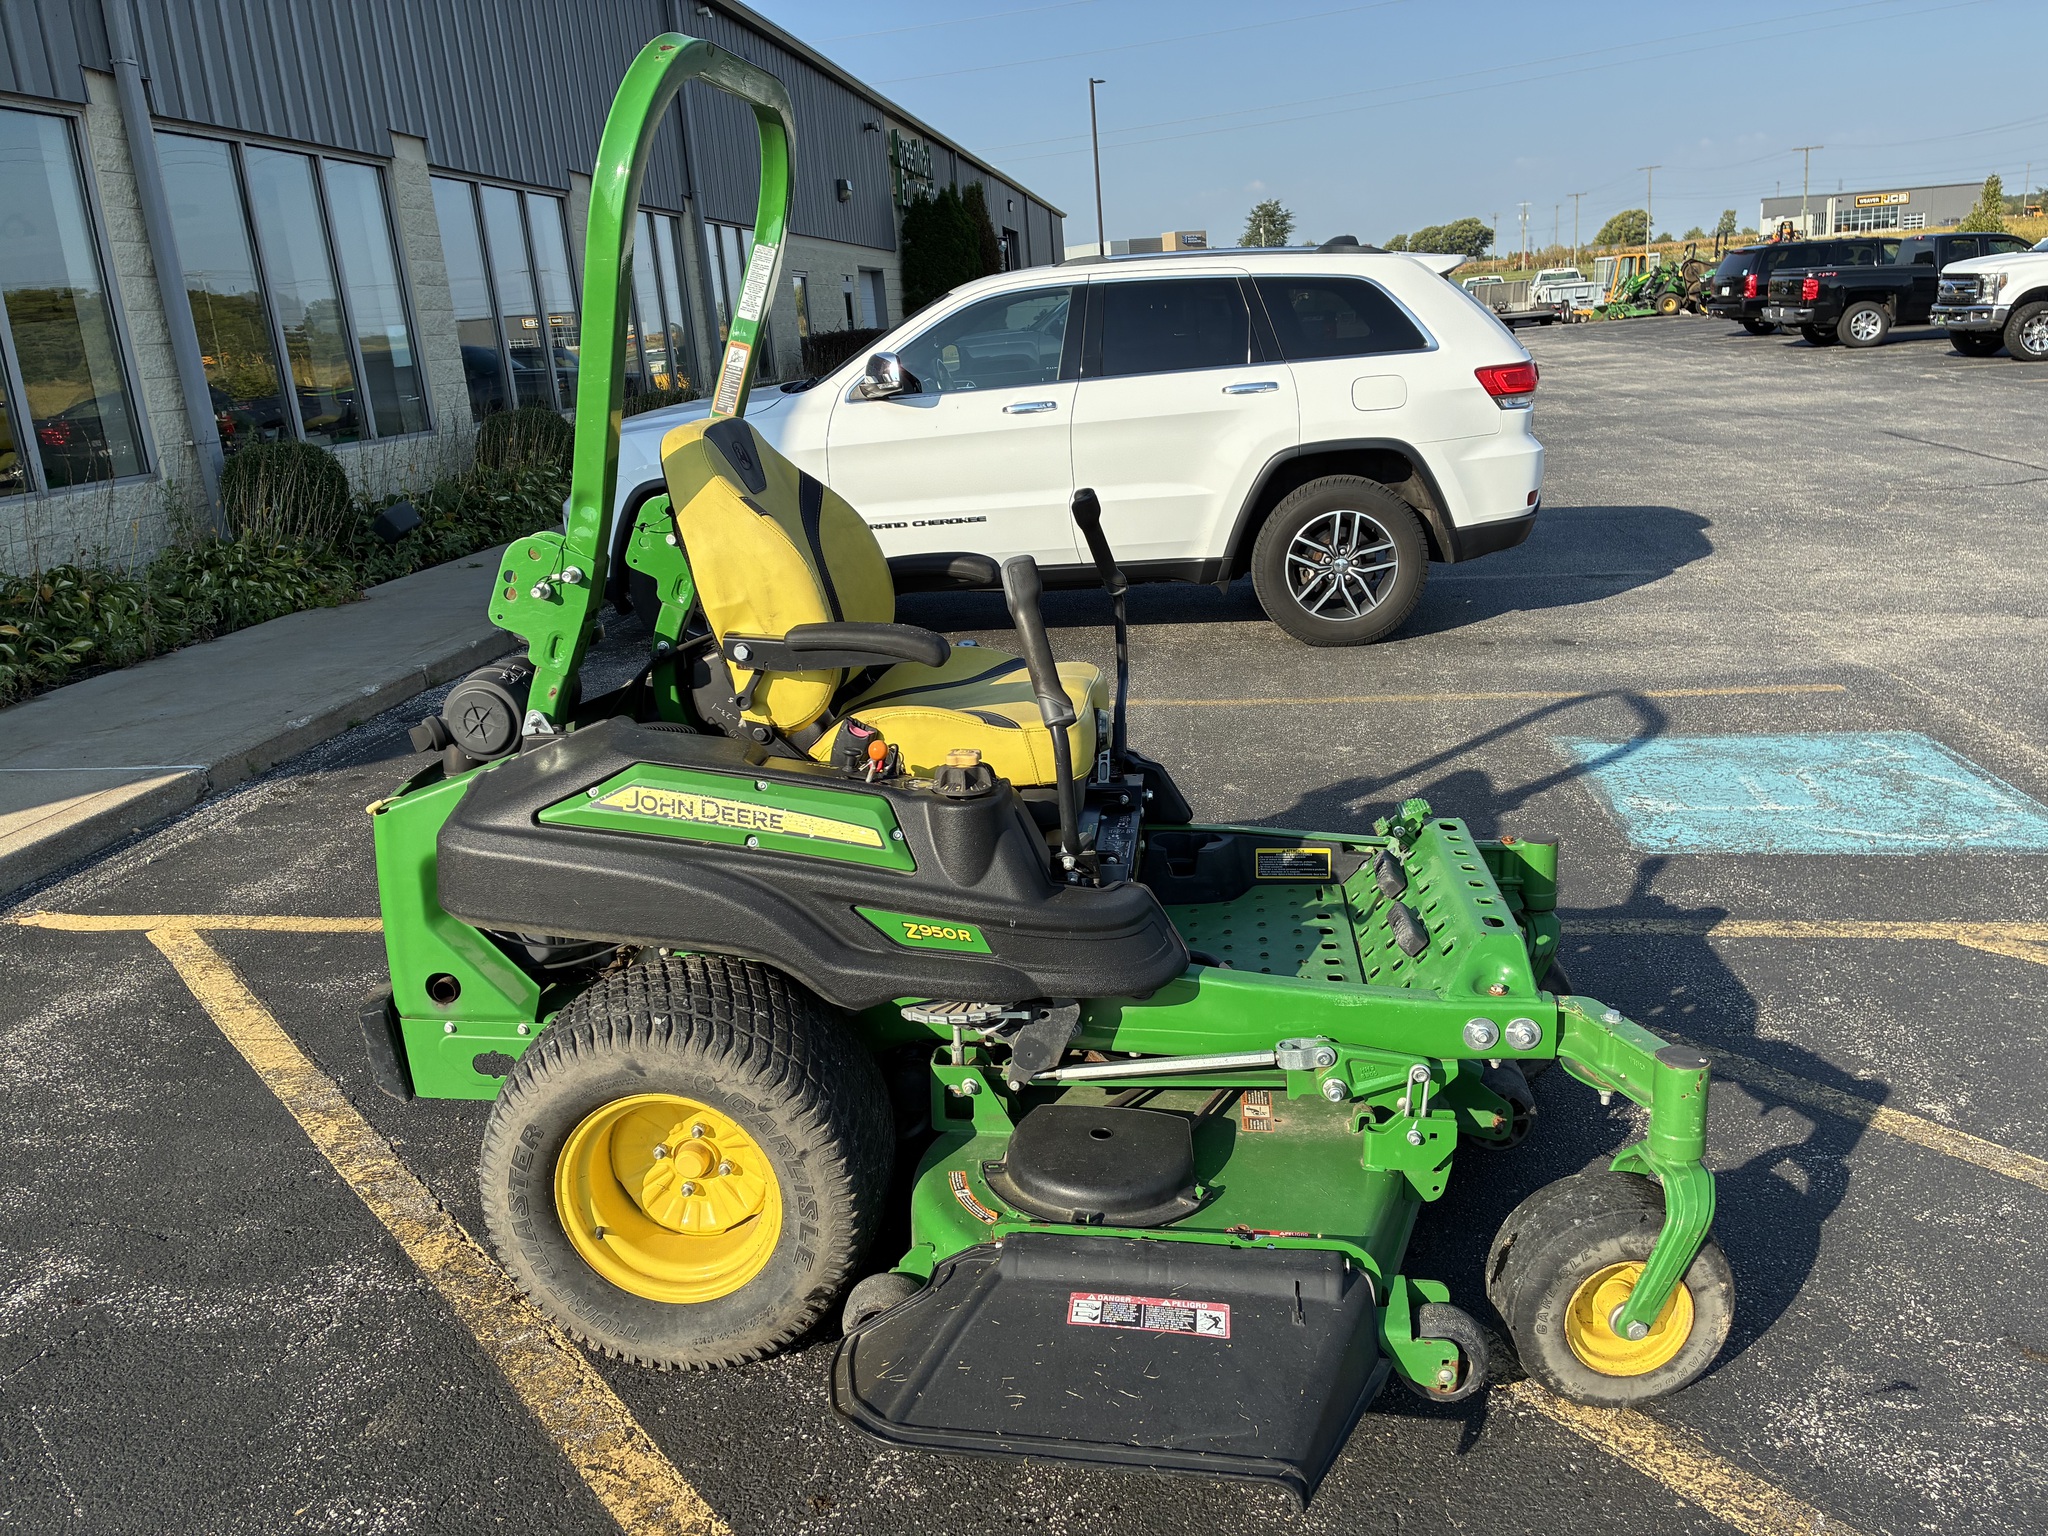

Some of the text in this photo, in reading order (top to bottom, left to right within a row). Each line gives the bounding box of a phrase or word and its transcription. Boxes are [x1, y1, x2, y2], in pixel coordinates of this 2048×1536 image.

[869, 516, 987, 530] RAND CHEROKEE
[625, 790, 783, 830] JOHN DEERE
[901, 921, 974, 942] Z950R
[723, 1091, 819, 1273] CARLISLE
[507, 1122, 640, 1345] TURF MASTER
[1097, 1294, 1208, 1310] DANGER PELIGRO
[1536, 1248, 1592, 1335] CARLISLE
